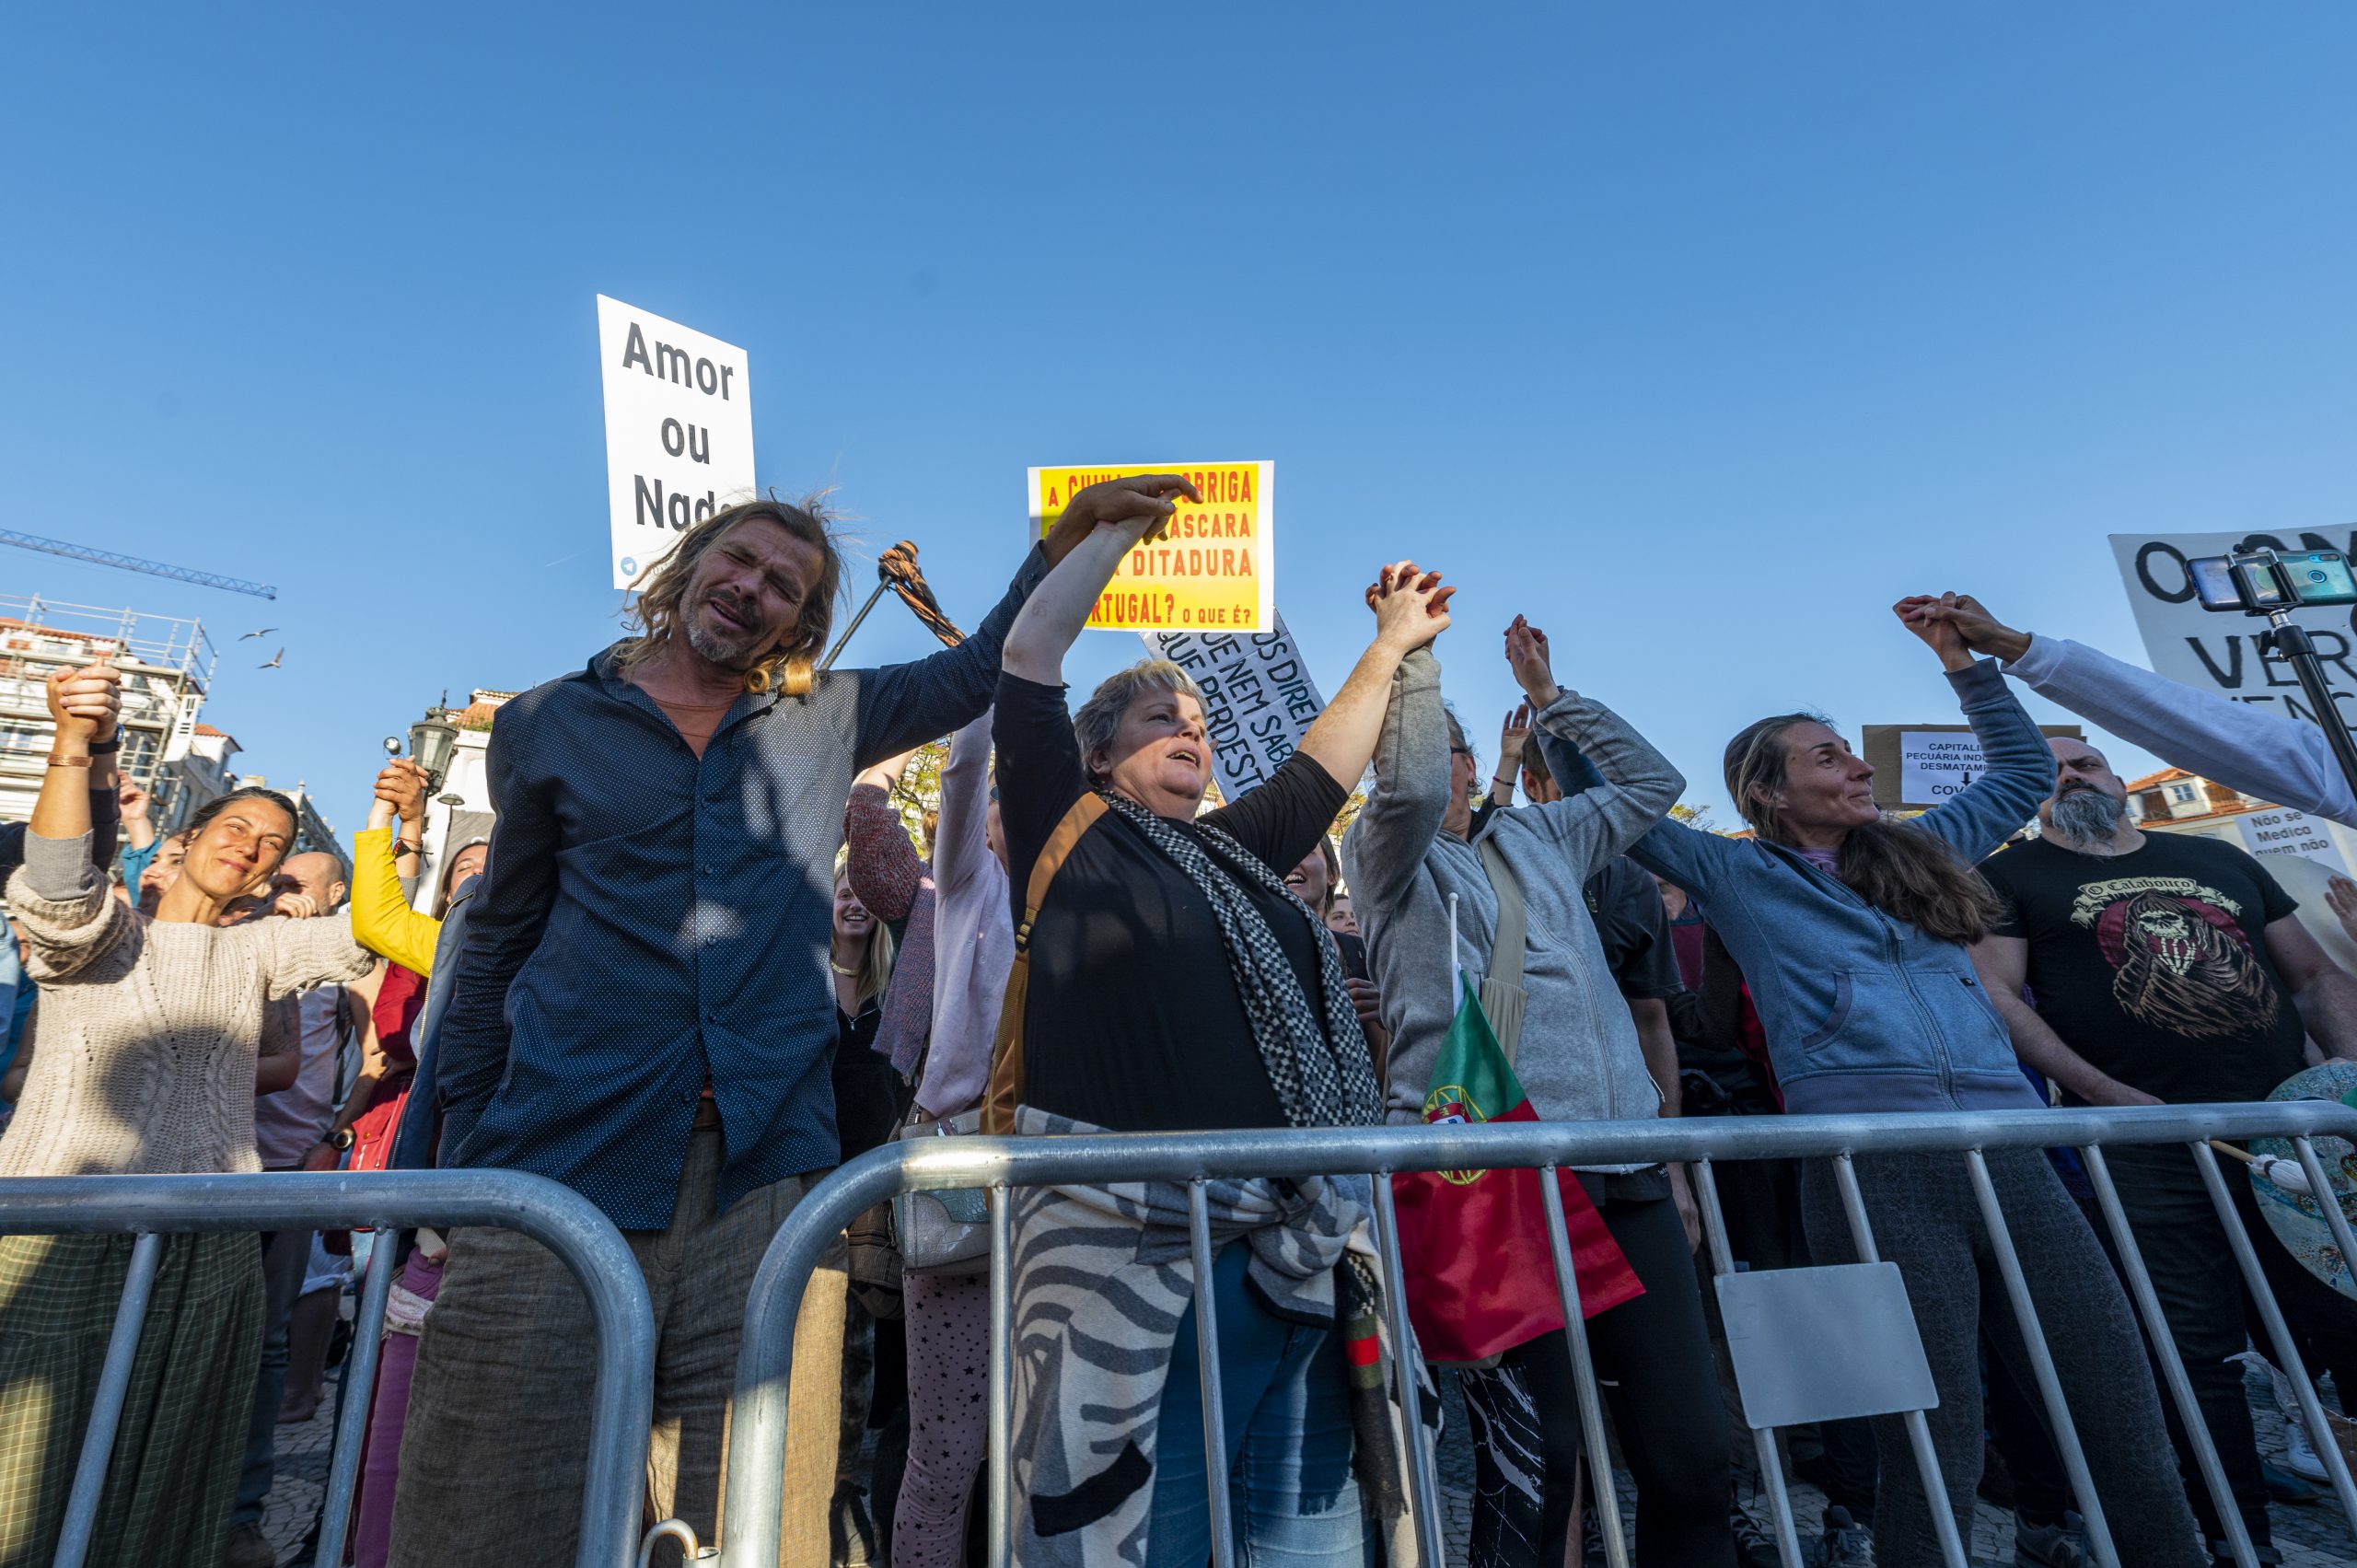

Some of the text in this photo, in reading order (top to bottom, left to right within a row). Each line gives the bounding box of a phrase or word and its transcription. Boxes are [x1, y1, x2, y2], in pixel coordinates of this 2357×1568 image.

[622, 321, 734, 401] Amor
[661, 417, 710, 465] ou
[633, 474, 734, 533] Nad
[1048, 486, 1059, 507] A
[1168, 507, 1251, 539] ÁSCARA
[1132, 549, 1253, 576] DITADURA
[2134, 541, 2197, 604] O
[1091, 593, 1176, 623] RTUGAL?
[1182, 608, 1190, 623] O
[1198, 608, 1225, 623] QUE
[1200, 633, 1242, 664] UE
[1218, 657, 1271, 716] NEM
[1266, 658, 1320, 736] DIREI
[1906, 750, 1961, 761] PECUÁRIA
[1928, 743, 1982, 752] CAPITALI
[1931, 784, 1965, 796] COV
[2251, 811, 2303, 828] Não se
[2256, 826, 2312, 842] Medica
[2300, 838, 2329, 853] não
